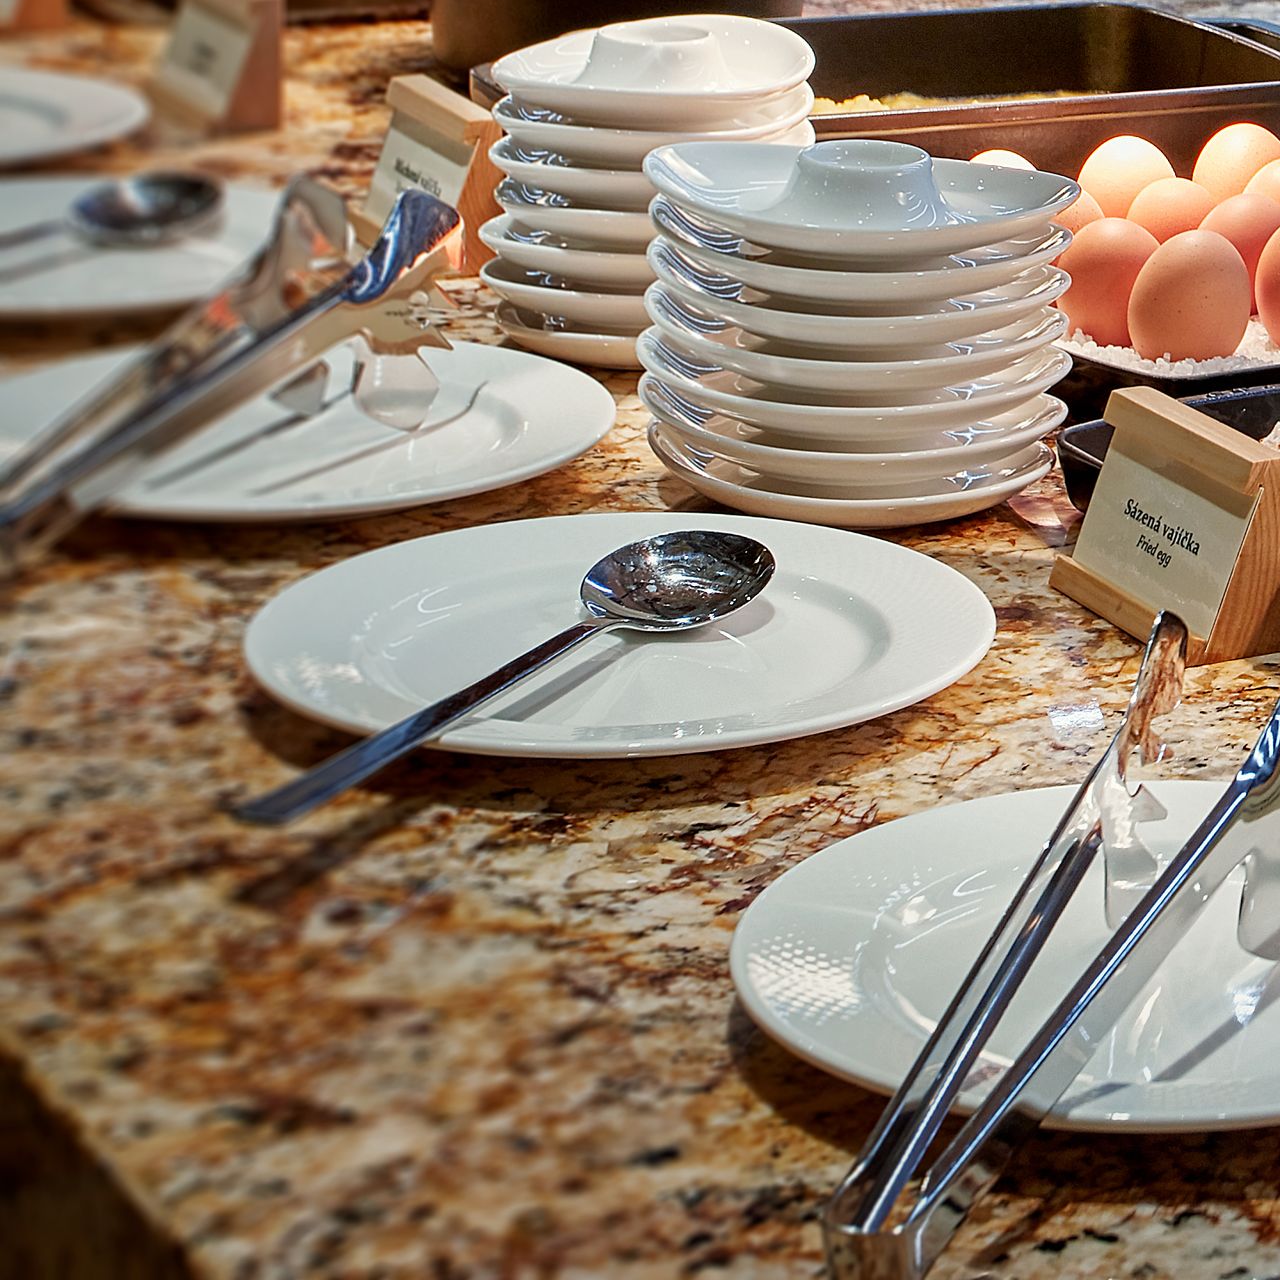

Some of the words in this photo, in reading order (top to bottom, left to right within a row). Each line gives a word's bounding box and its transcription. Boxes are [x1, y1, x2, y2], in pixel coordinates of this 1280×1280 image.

[1124, 499, 1162, 533] Sázená
[1162, 523, 1200, 556] vajíčka
[1136, 534, 1159, 557] Fried
[1157, 549, 1172, 568] egg
